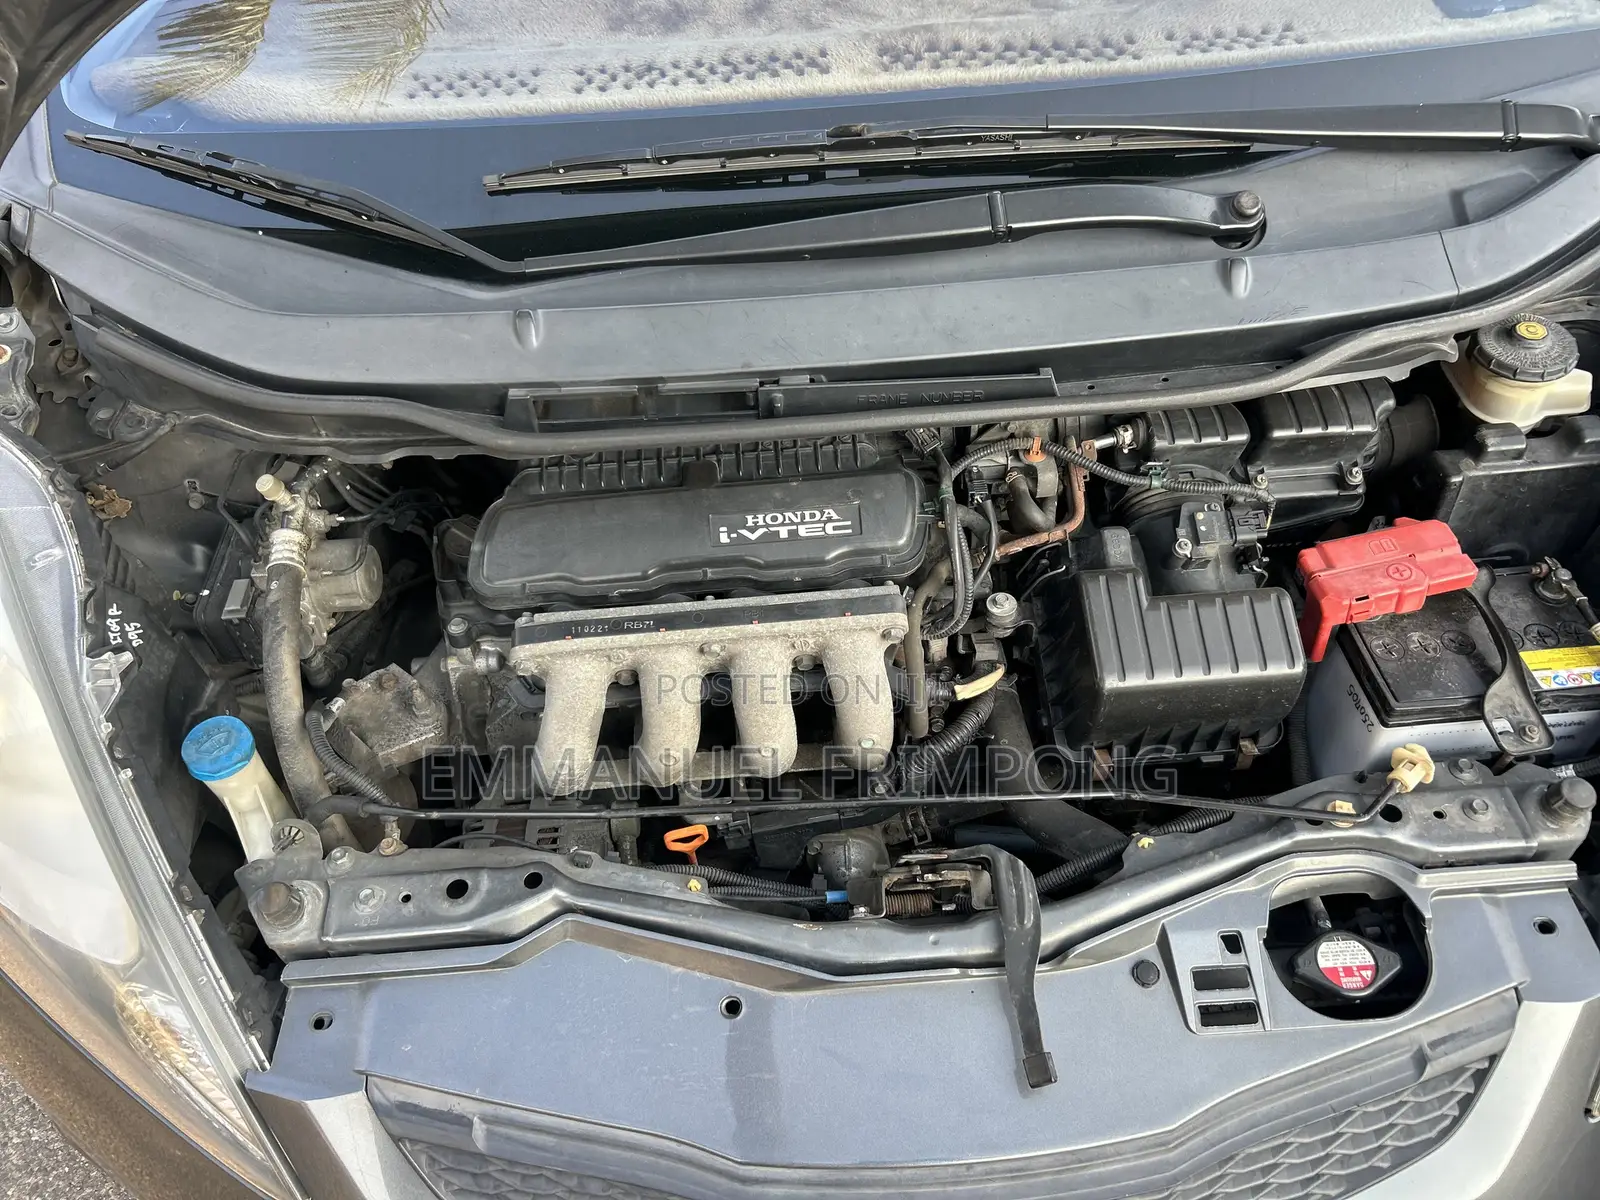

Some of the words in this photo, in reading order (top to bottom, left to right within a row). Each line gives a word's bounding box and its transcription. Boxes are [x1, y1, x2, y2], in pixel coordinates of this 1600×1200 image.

[856, 392, 909, 405] FRAME
[920, 389, 985, 405] NUMBER
[744, 508, 843, 527] HONDA
[718, 520, 853, 544] i-VTEC
